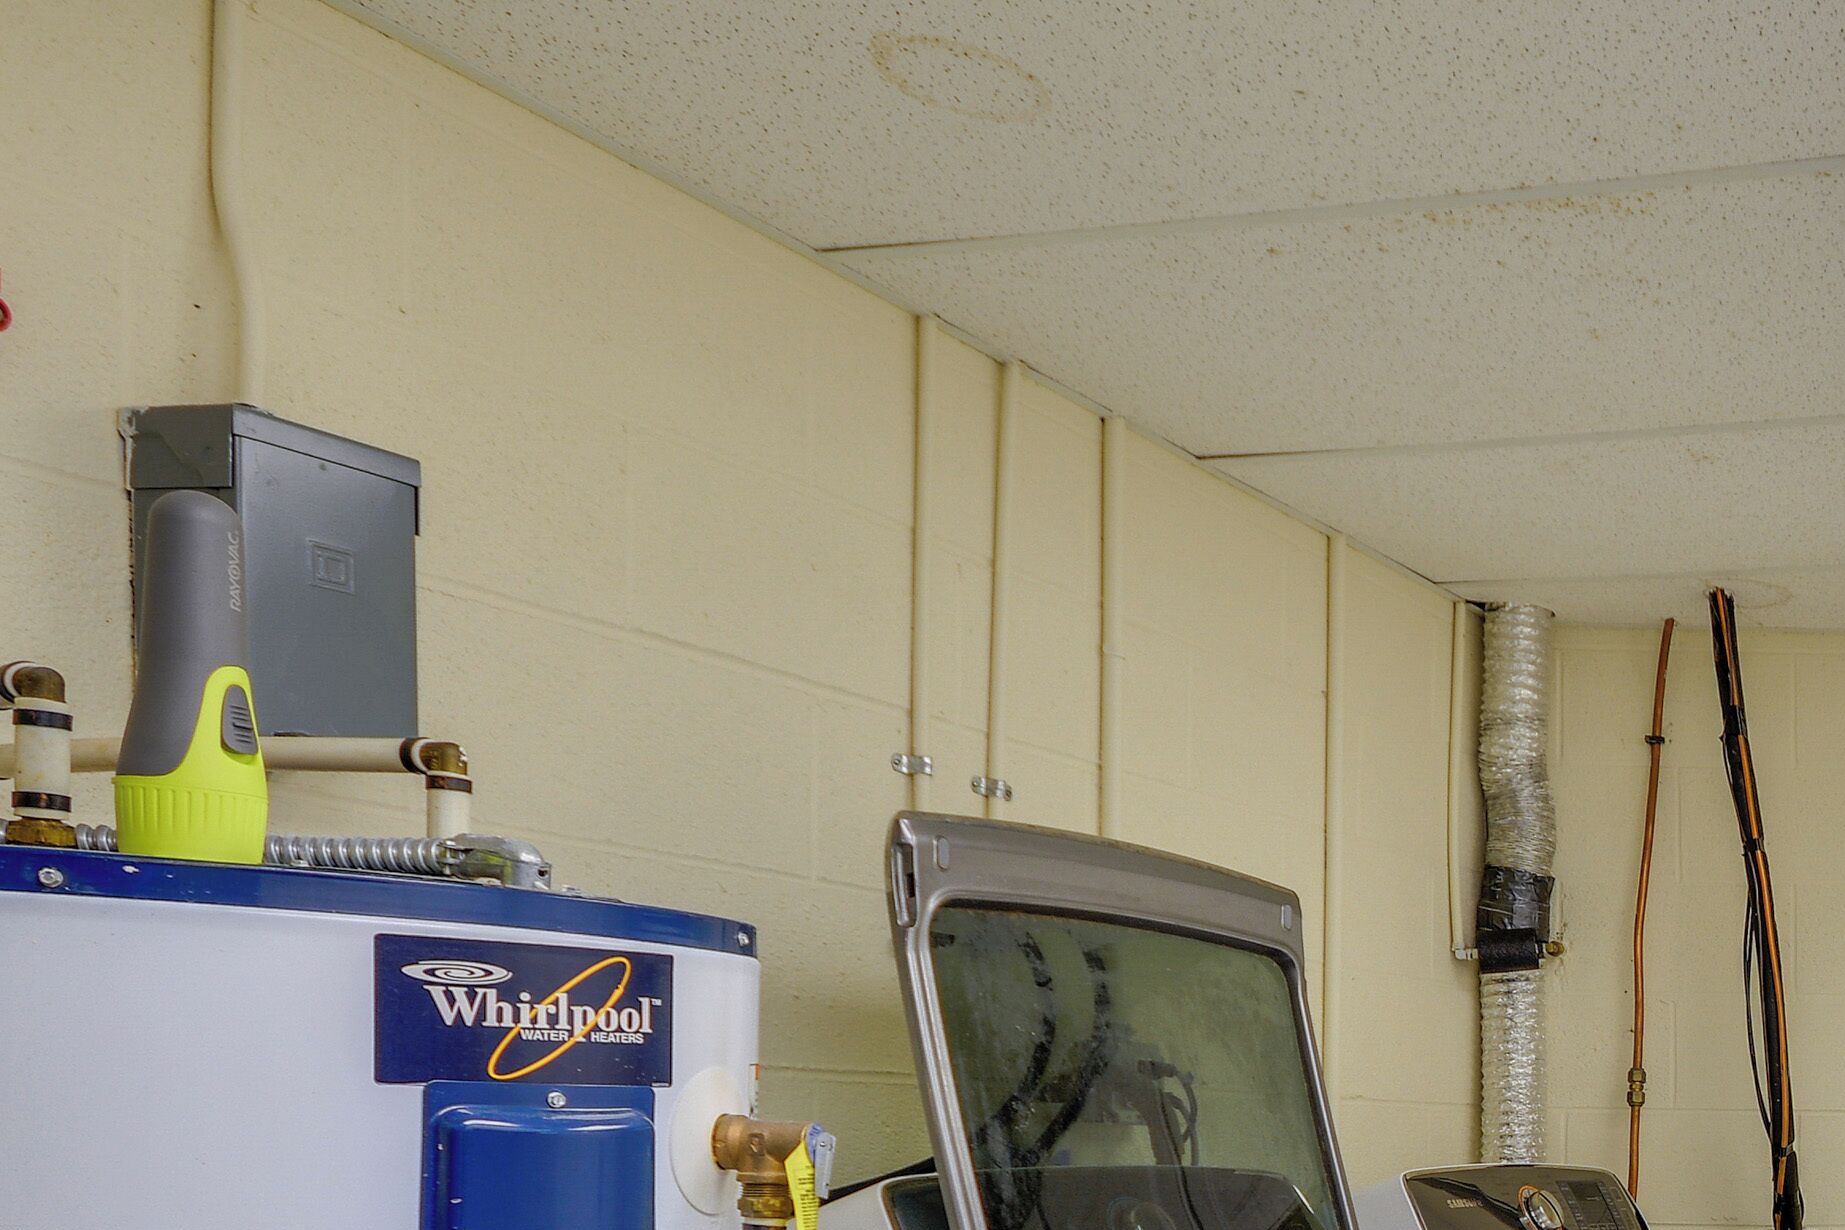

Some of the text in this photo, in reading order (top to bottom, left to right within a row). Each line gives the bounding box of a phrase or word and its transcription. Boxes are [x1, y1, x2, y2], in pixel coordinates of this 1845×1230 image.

[423, 984, 653, 1043] Whirlpool
[520, 1029, 644, 1045] WATER HEATERS
